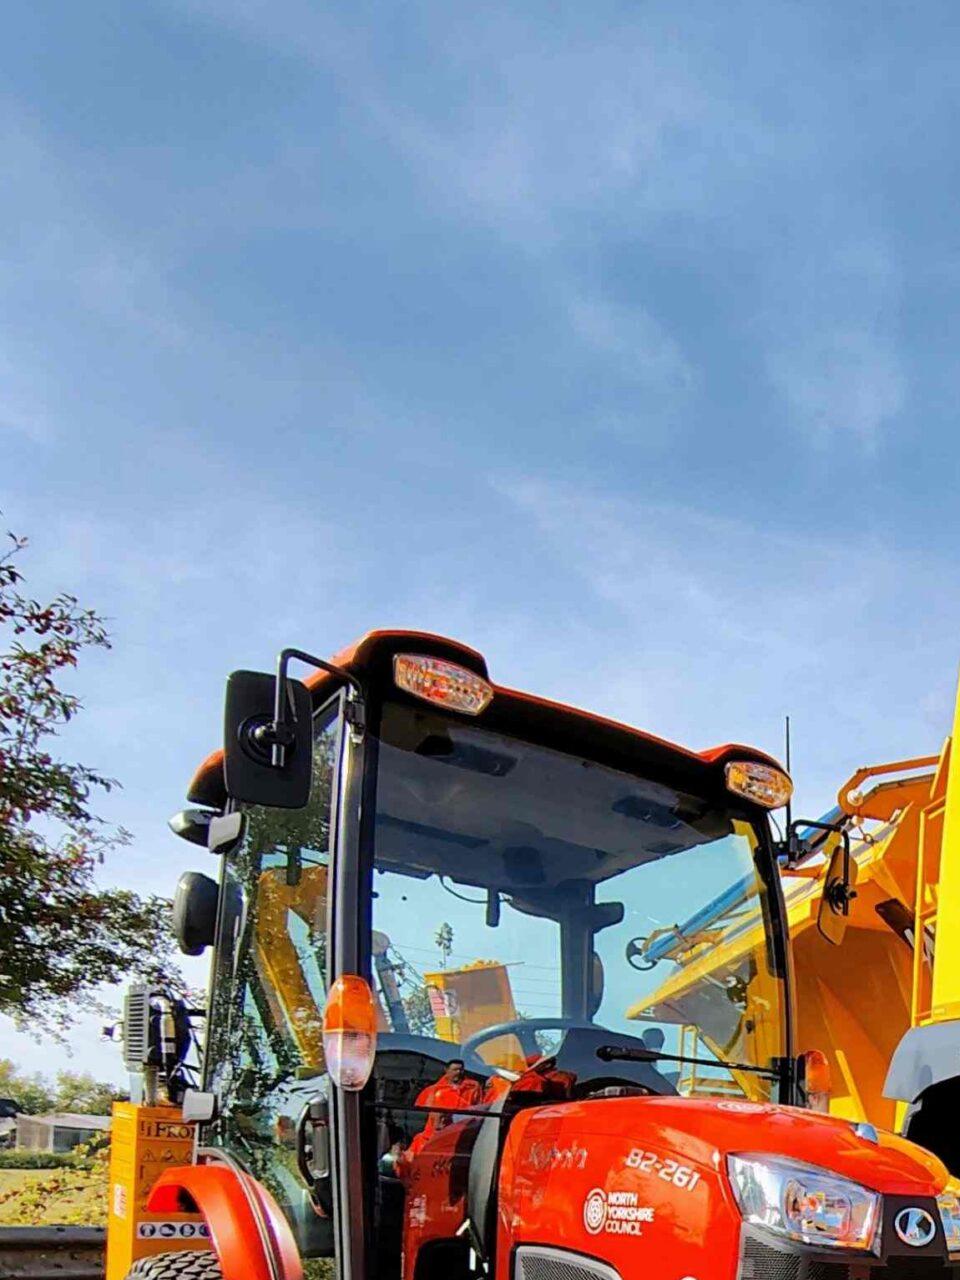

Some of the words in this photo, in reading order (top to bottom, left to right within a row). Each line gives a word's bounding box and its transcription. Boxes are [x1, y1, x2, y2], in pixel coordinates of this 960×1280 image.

[608, 1192, 638, 1206] NORTH
[607, 1206, 655, 1222] YORKSHIRE
[605, 1220, 642, 1236] COUNCIL
